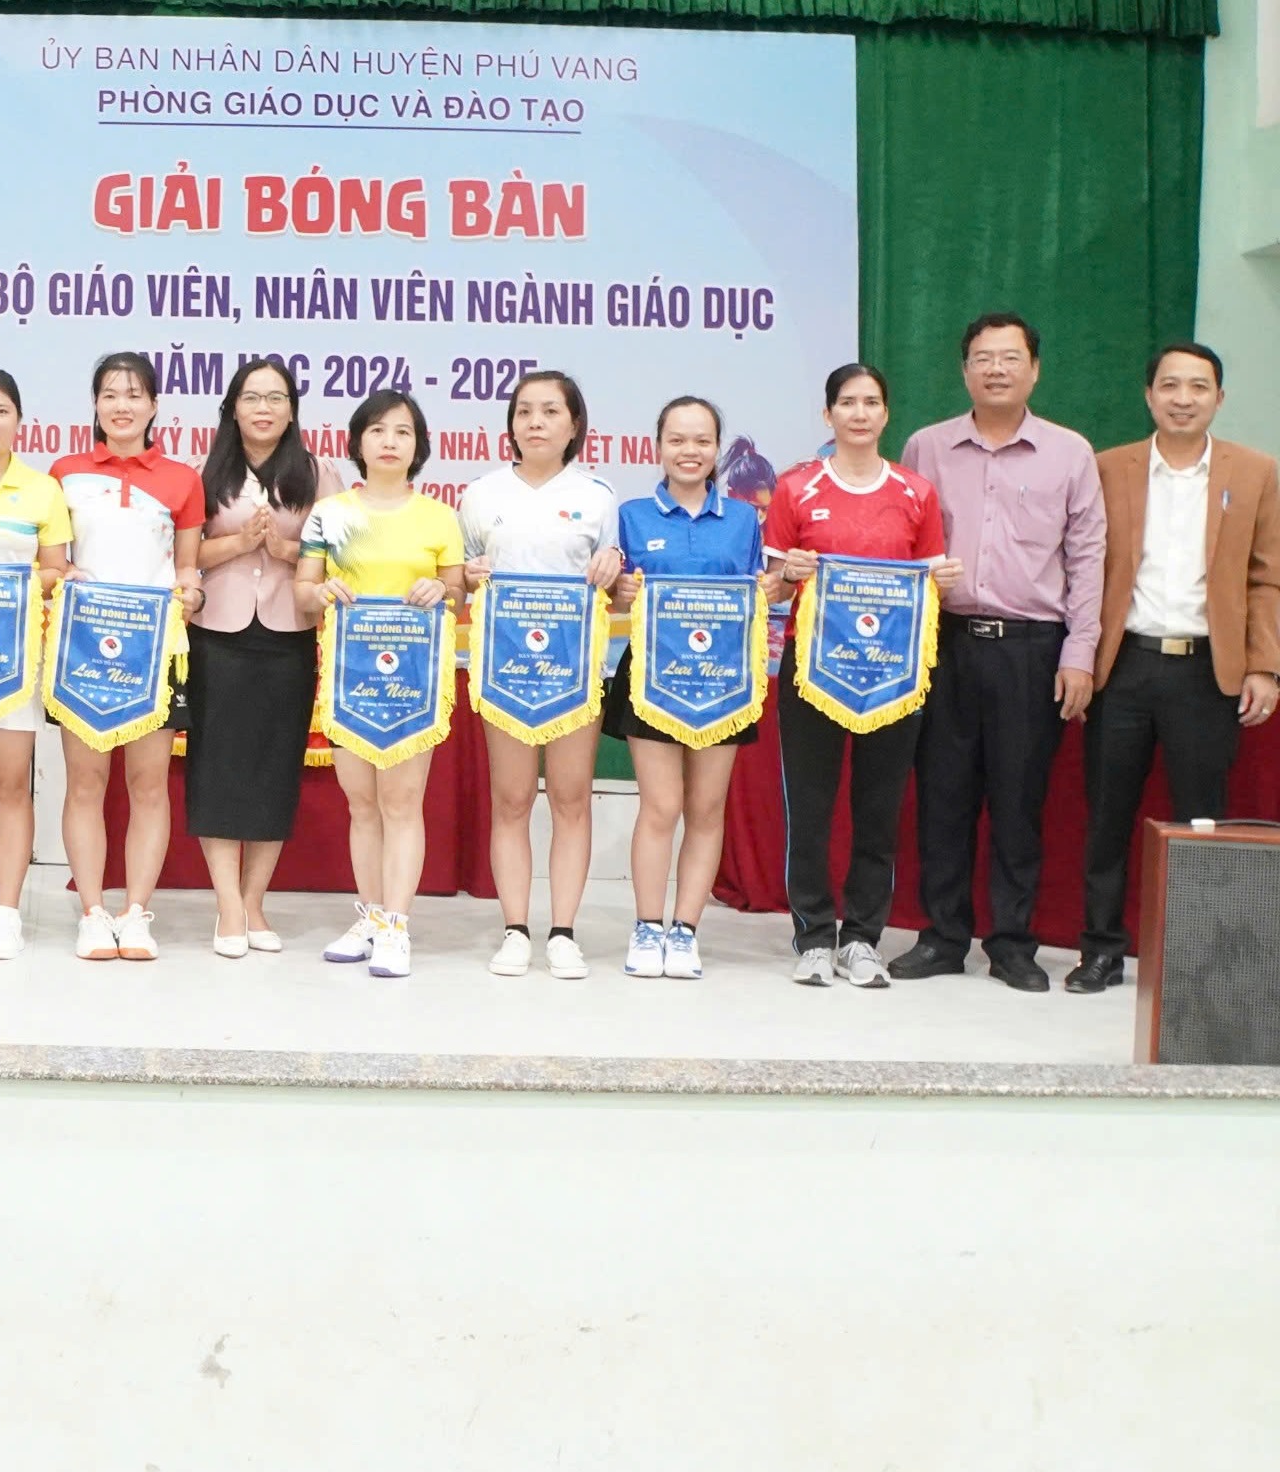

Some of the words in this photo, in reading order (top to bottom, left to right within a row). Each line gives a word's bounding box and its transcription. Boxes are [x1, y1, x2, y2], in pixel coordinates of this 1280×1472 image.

[42, 38, 82, 69] ỦY
[96, 46, 159, 70] BAN
[173, 43, 261, 72] NHÂN
[275, 44, 339, 74] DÂN
[353, 47, 462, 80] HUYỆN
[476, 49, 540, 78] PHÚ
[551, 56, 638, 81] VANG
[98, 84, 212, 114] PHÒNG
[224, 86, 303, 116] GIÁO
[314, 93, 379, 122] DỤC
[391, 89, 433, 119] VÀ
[444, 90, 511, 121] ĐÀO
[521, 98, 584, 127] TẠO
[93, 161, 221, 233] GIẢI
[244, 165, 427, 238] BÓNG
[448, 169, 585, 238] BÀN
[49, 265, 134, 317] GIÁO
[147, 265, 241, 324] VIÊN,
[256, 268, 358, 321] NHÂN
[371, 269, 454, 322] VIÊN
[467, 272, 593, 326] NGÀNH
[606, 275, 690, 329] GIÁO
[703, 286, 774, 339] DỤC
[323, 355, 412, 398] 2024
[425, 377, 438, 386] -
[13, 418, 61, 453] HÀO
[152, 417, 183, 454] KỶ
[440, 426, 490, 461] NHÀ
[578, 429, 613, 470] IỆT
[622, 436, 663, 465] NA
[353, 622, 373, 633] GIẢI
[376, 623, 402, 633] BÓNG
[404, 624, 425, 634] BÀN
